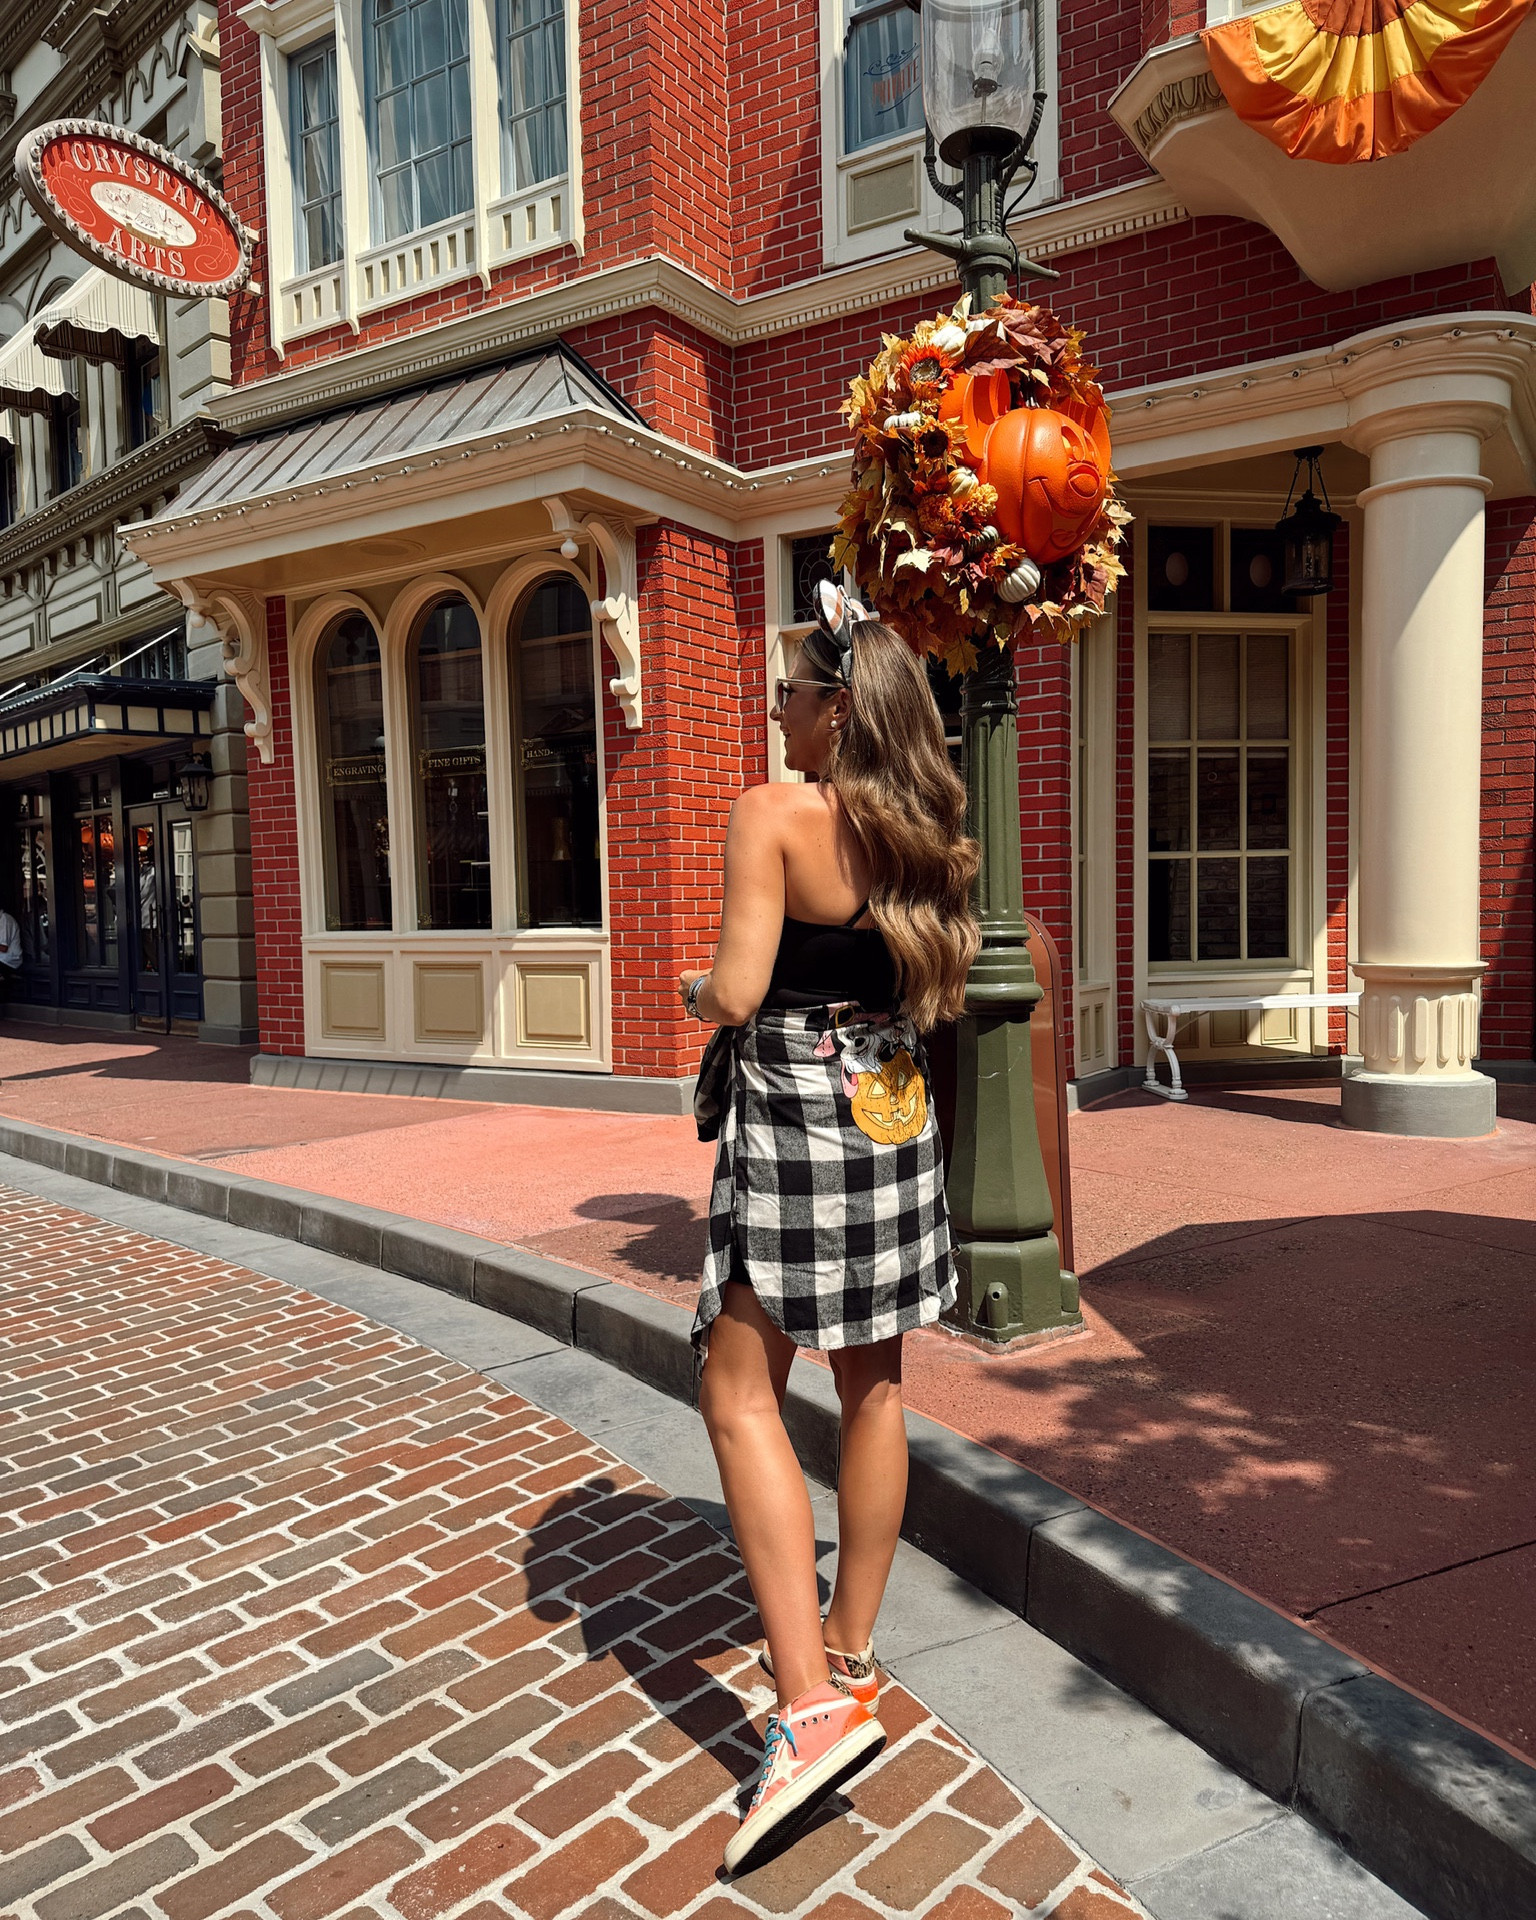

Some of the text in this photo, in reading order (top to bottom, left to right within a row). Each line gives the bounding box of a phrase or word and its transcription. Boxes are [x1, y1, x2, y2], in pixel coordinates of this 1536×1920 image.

[872, 56, 919, 107] PRIVATE
[71, 141, 208, 226] CRYSTAL
[107, 225, 187, 277] ARTS
[333, 764, 385, 777] ENGRAVING
[428, 755, 482, 769] FINE GIFTS
